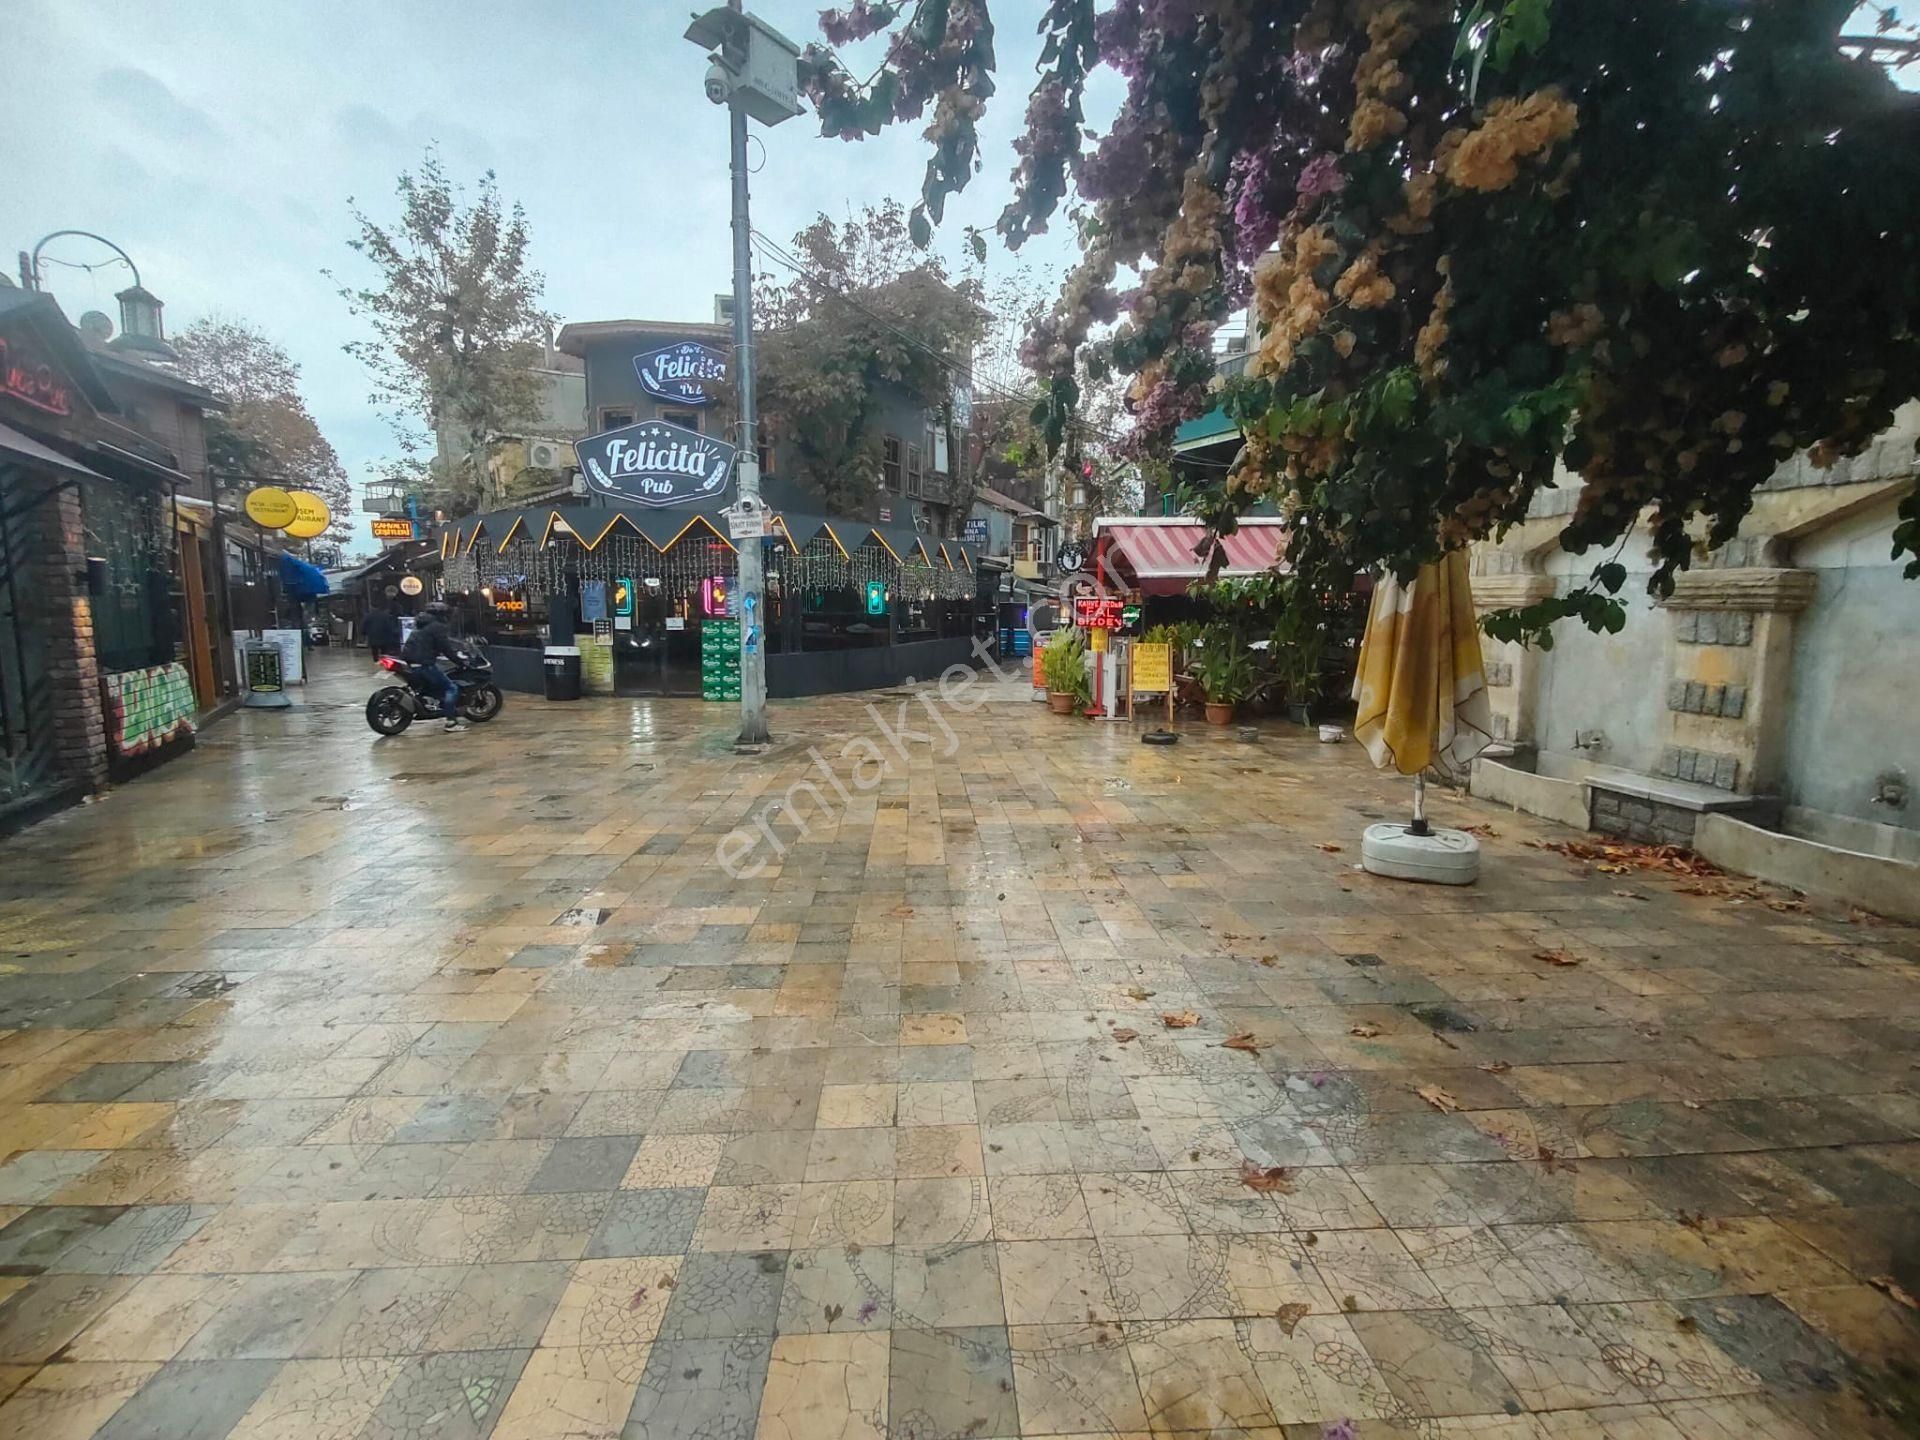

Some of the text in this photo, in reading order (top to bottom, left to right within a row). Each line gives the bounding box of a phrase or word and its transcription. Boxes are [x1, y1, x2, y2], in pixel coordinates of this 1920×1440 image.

[606, 439, 706, 477] Felicita
[641, 478, 674, 494] Pub
[1087, 607, 1114, 617] FAL
